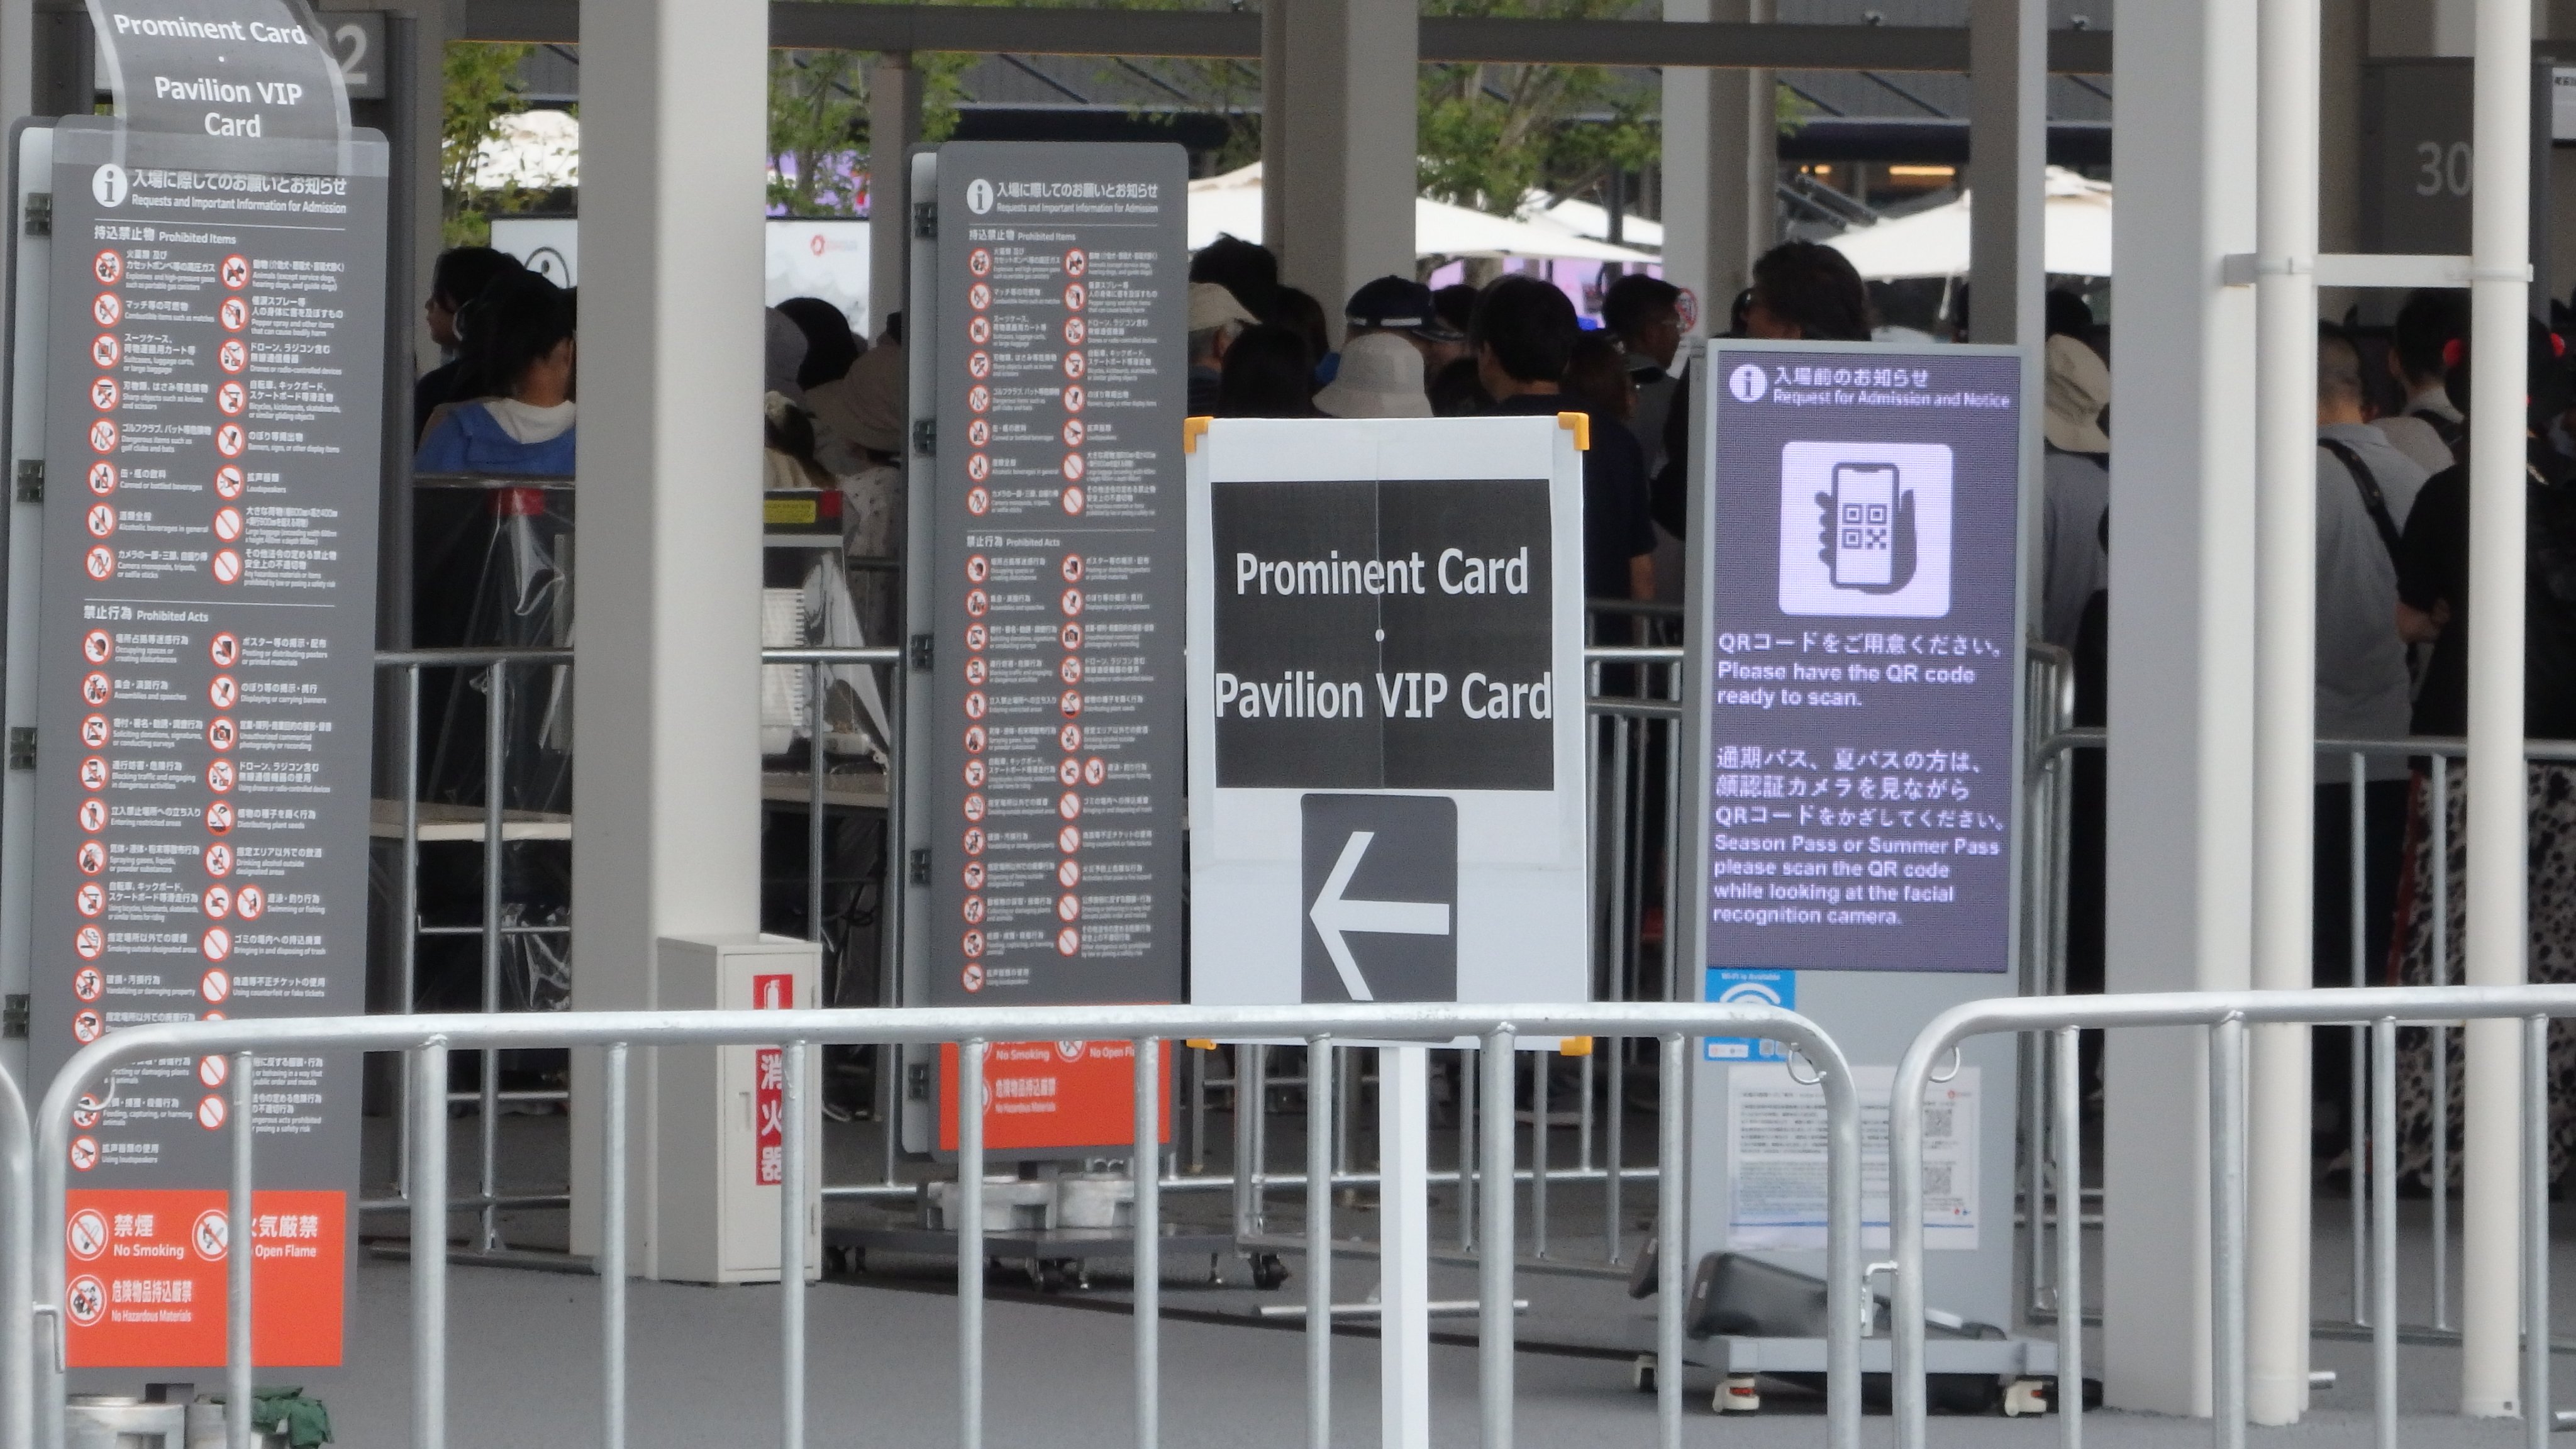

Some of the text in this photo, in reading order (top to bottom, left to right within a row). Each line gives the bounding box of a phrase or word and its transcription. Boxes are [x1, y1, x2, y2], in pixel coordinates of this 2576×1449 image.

[113, 14, 308, 45] Prominent Card
[154, 76, 303, 105] Pavilion VIP
[204, 113, 261, 138] Card
[2416, 140, 2474, 197] 30
[132, 169, 347, 197] 入場に際してのお願いとお知らせ
[997, 182, 1158, 199] 入場に際してのお願いとお知らせ
[131, 193, 347, 214] Requests and Important Information for Admission
[996, 202, 1158, 214] Requests and Important Information for Admission
[94, 225, 155, 242] 持込禁止物
[158, 231, 237, 245] Prohibited Items
[969, 229, 1014, 241] 持込禁止物
[1018, 231, 1077, 242] Prohibited Items
[250, 342, 331, 354] ドローン、ラジコン含む
[1774, 367, 1929, 389] 入場前のお知らせ
[1773, 389, 2010, 408] Request for Admission and Notice
[967, 535, 1003, 548] 禁止行為
[1006, 538, 1060, 547] Prohibited Acts
[1236, 546, 1528, 596] Prominent Card
[84, 605, 132, 621] 禁止行為
[136, 609, 209, 622] Prohibited Acts
[1718, 631, 2001, 657] QRコードをご用意ください。
[1718, 660, 1975, 683] Please have the QR code
[1215, 670, 1552, 719] Pavilion VIP Card
[1718, 689, 1862, 709] ready to scan.
[240, 761, 319, 773] ドローン、ラジコン含む
[1716, 745, 1979, 773] 通期パス、夏パスの方は、
[1716, 774, 1969, 801] 顔認証カメラを見ながら
[1715, 804, 2003, 831] QRコードをかざしてください。
[1715, 834, 2000, 855] Season Pass or Summer Pass
[1714, 859, 1951, 879] please scan the QR code
[1714, 882, 1954, 904] while looking at the facial
[1713, 907, 1902, 926] recognition camera.
[996, 1050, 1050, 1062] No Smoking
[1089, 1048, 1101, 1058] No
[1101, 1048, 1122, 1060] Open
[760, 1053, 782, 1183] 消火器
[114, 1214, 154, 1238] 禁煙
[113, 1243, 184, 1260] No Smoking
[255, 1244, 317, 1260] Open Flame
[112, 1280, 192, 1303] 危険物品持込厳禁
[111, 1309, 192, 1322] No Hazardous Materials
